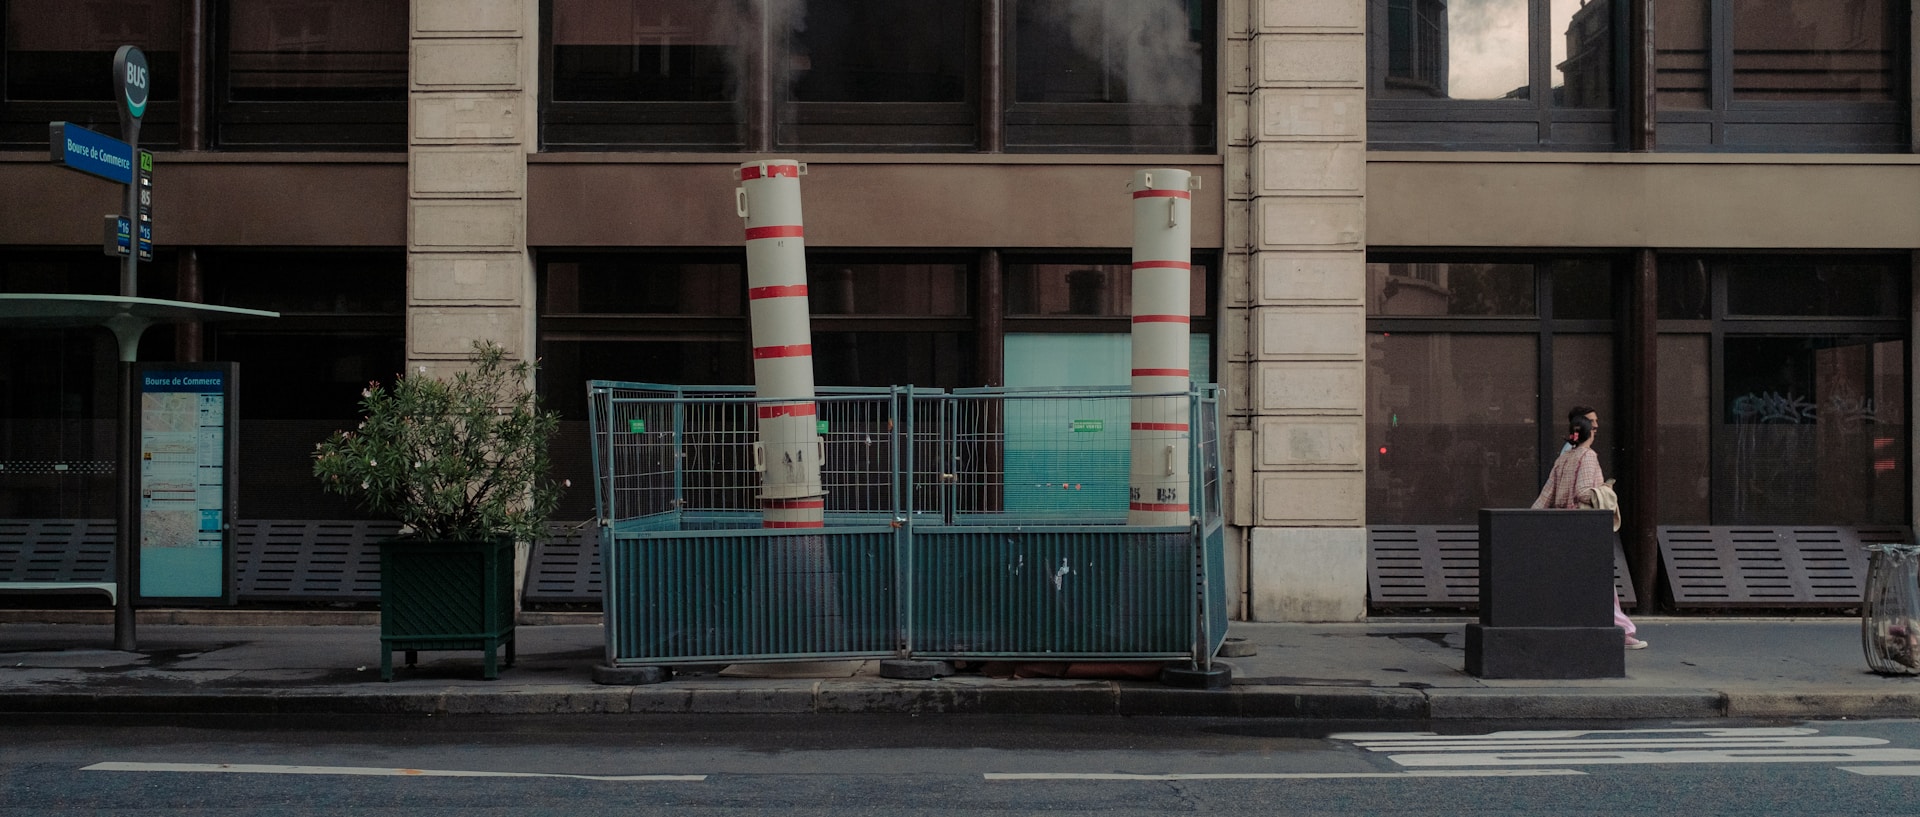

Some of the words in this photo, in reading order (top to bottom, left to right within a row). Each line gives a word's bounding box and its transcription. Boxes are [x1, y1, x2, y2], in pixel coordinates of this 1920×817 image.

[127, 62, 146, 89] BUS
[67, 138, 89, 156] Bourse
[90, 146, 98, 159] de
[99, 149, 130, 170] Commerce
[142, 154, 151, 170] 74
[141, 190, 151, 206] 85
[145, 377, 170, 386] Bourse
[171, 377, 181, 386] de
[183, 377, 221, 386] Commerce
